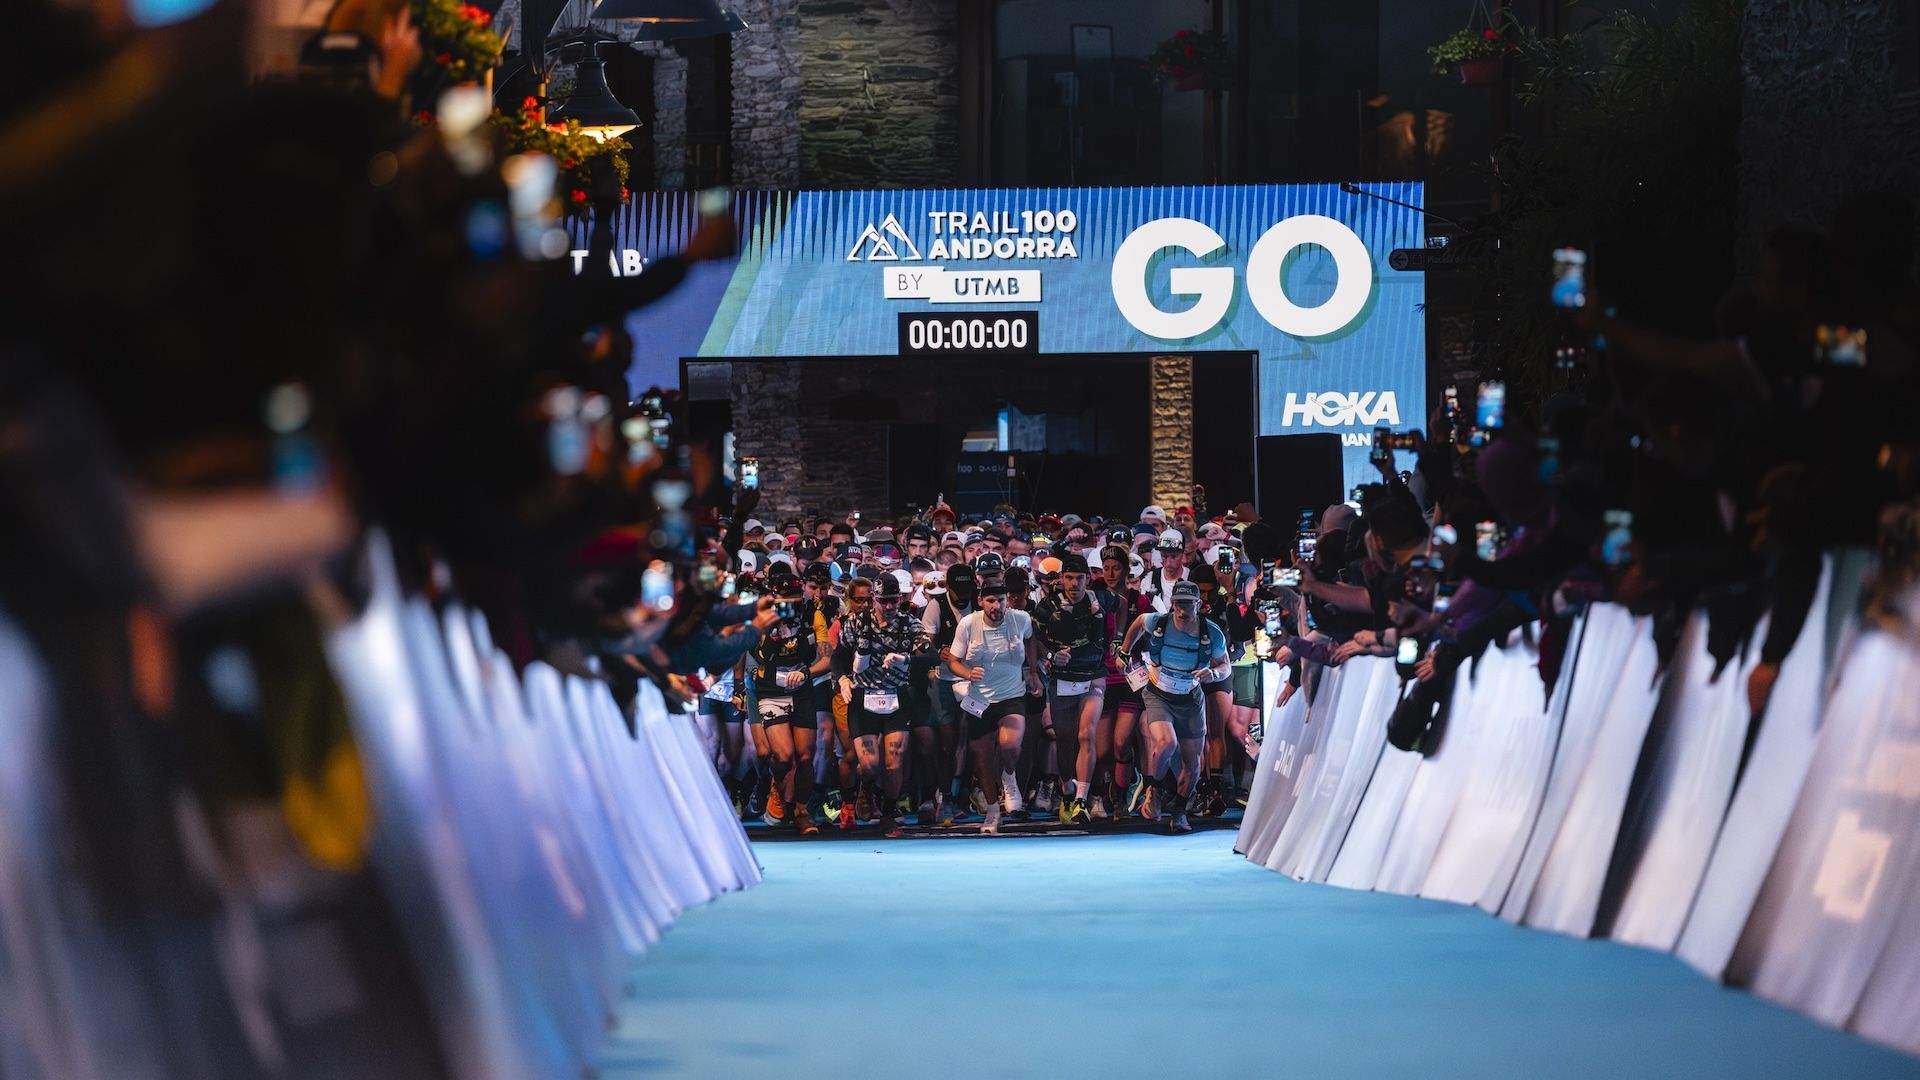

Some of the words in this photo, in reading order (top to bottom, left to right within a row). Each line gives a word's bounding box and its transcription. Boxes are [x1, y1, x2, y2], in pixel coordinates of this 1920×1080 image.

[928, 236, 1078, 260] ANDORRA
[897, 273, 923, 291] BY
[954, 277, 1020, 296] UTMB
[1112, 214, 1373, 339] GO
[909, 318, 1028, 350] 00:00:00
[1281, 390, 1400, 427] HOKA
